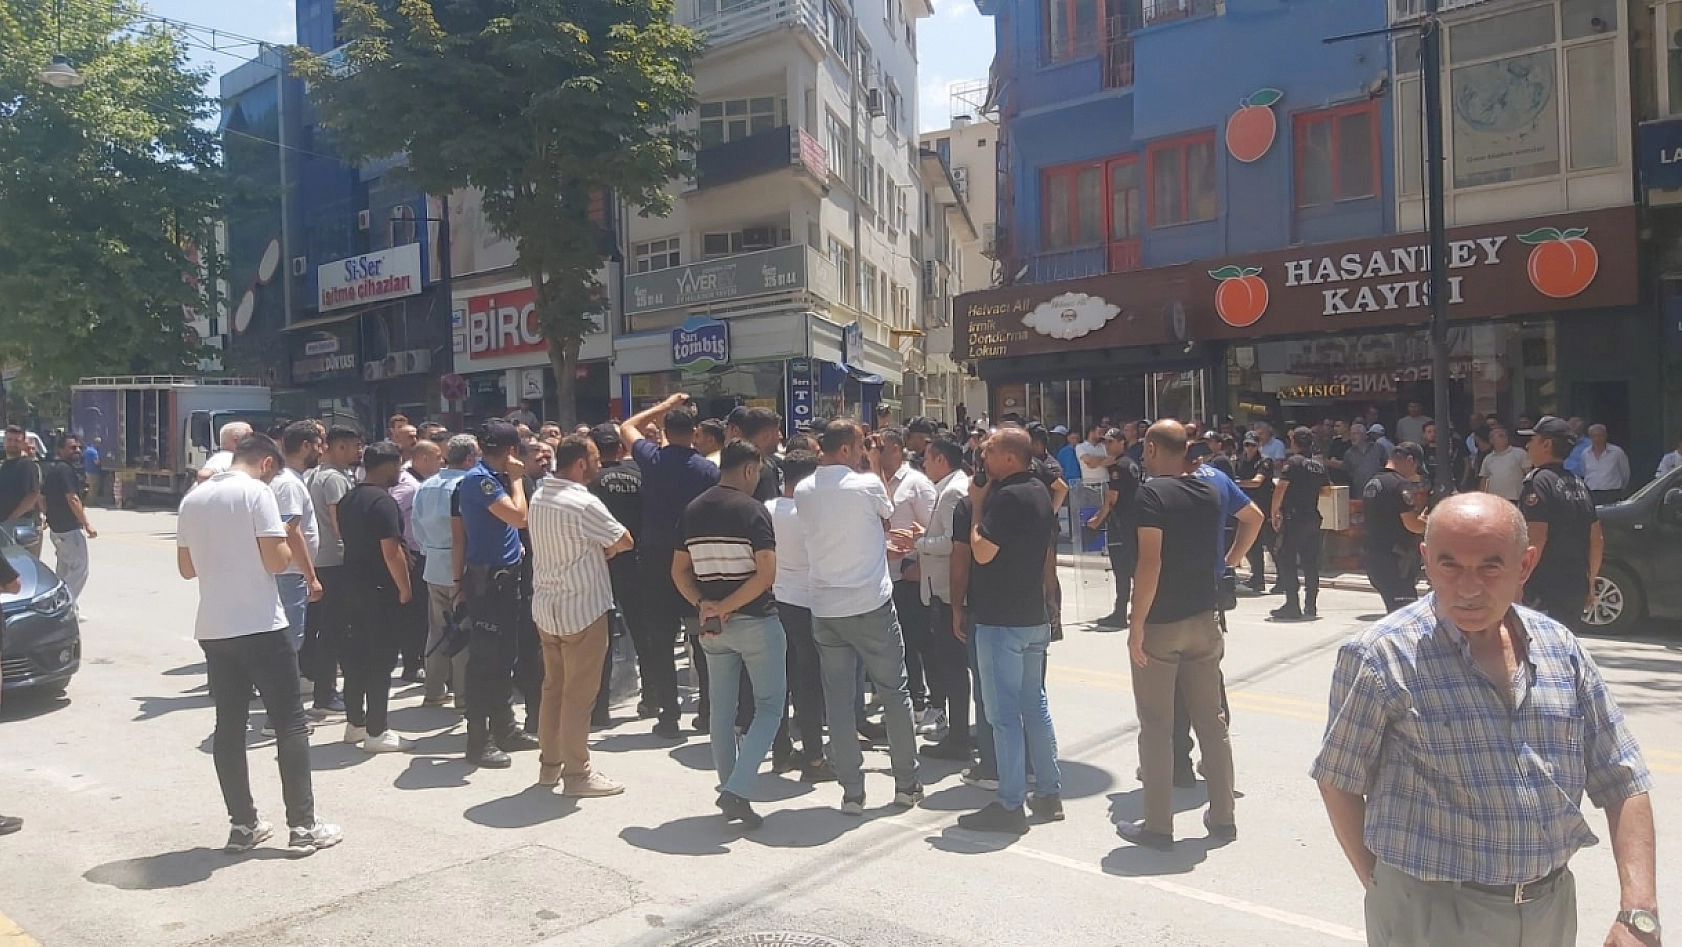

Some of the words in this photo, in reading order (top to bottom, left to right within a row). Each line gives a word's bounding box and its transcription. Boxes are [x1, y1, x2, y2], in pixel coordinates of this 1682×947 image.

[1284, 235, 1508, 288] HASANEY
[1321, 275, 1464, 317] KAYII
[673, 335, 725, 360] tombiş
